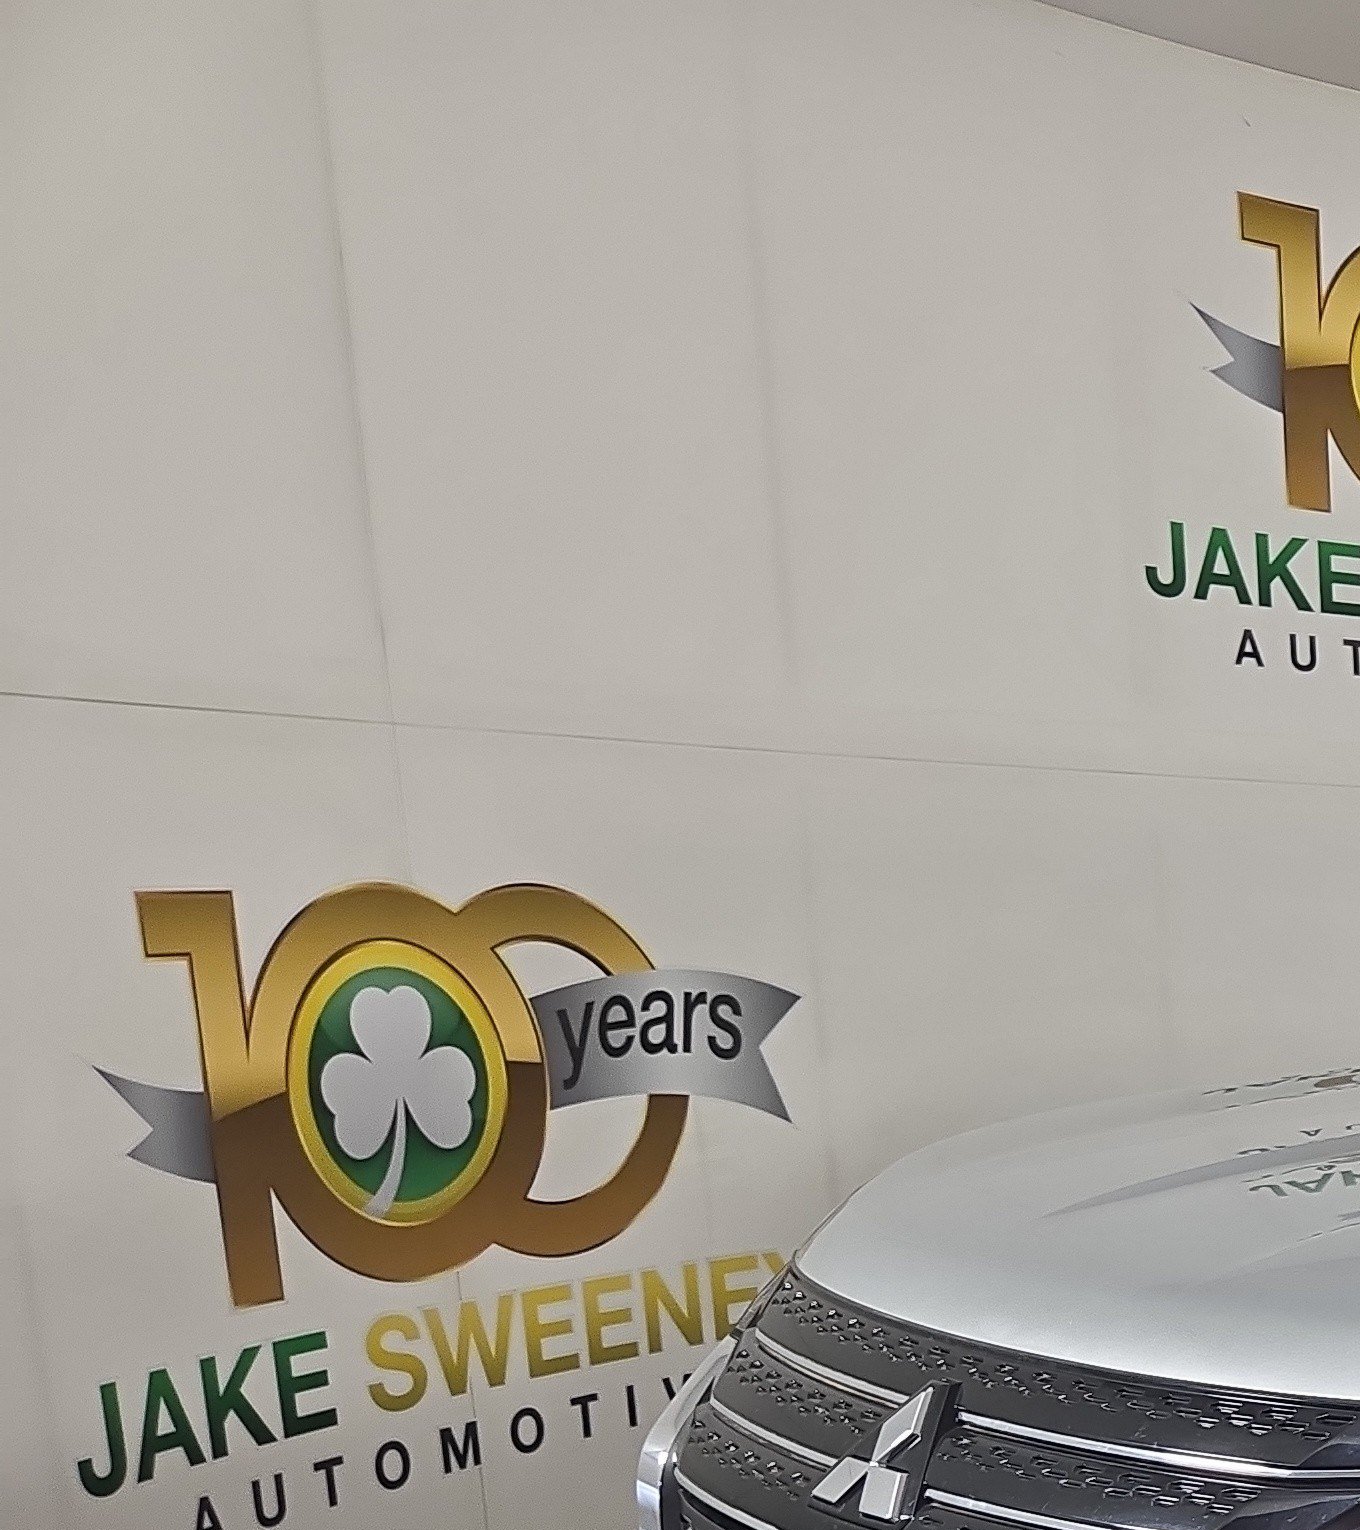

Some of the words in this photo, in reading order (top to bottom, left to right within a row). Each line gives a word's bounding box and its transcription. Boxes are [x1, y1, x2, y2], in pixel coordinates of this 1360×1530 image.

[135, 881, 690, 1307] 100
[556, 988, 743, 1089] years
[77, 1331, 338, 1498] JAKE
